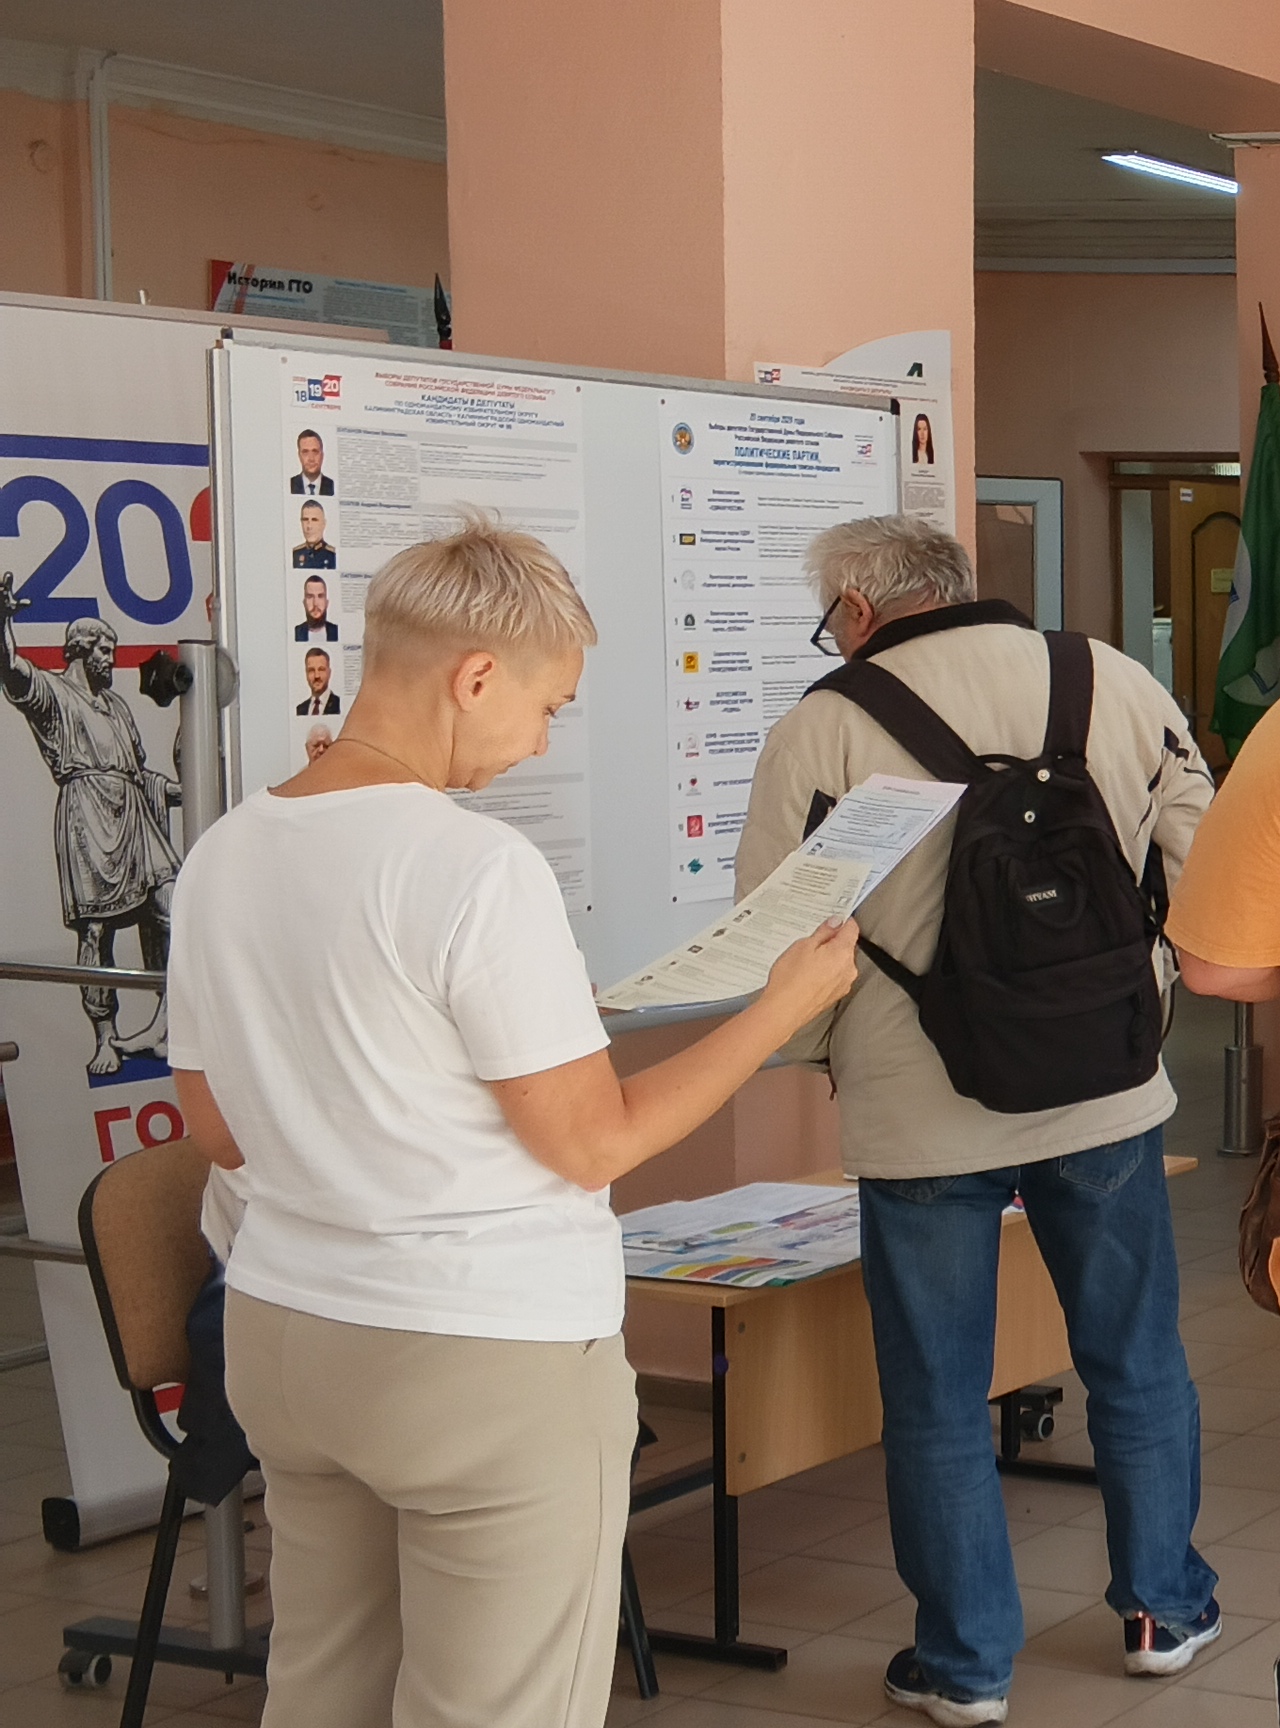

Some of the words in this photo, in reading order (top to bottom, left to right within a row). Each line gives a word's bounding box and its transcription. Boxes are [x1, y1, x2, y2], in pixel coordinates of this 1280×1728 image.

[227, 271, 284, 293] История
[287, 279, 313, 294] ГТО
[295, 390, 307, 402] 18
[309, 384, 322, 397] 19
[323, 379, 340, 392] 20
[0, 475, 212, 625] 20
[94, 1100, 185, 1163] ГО
